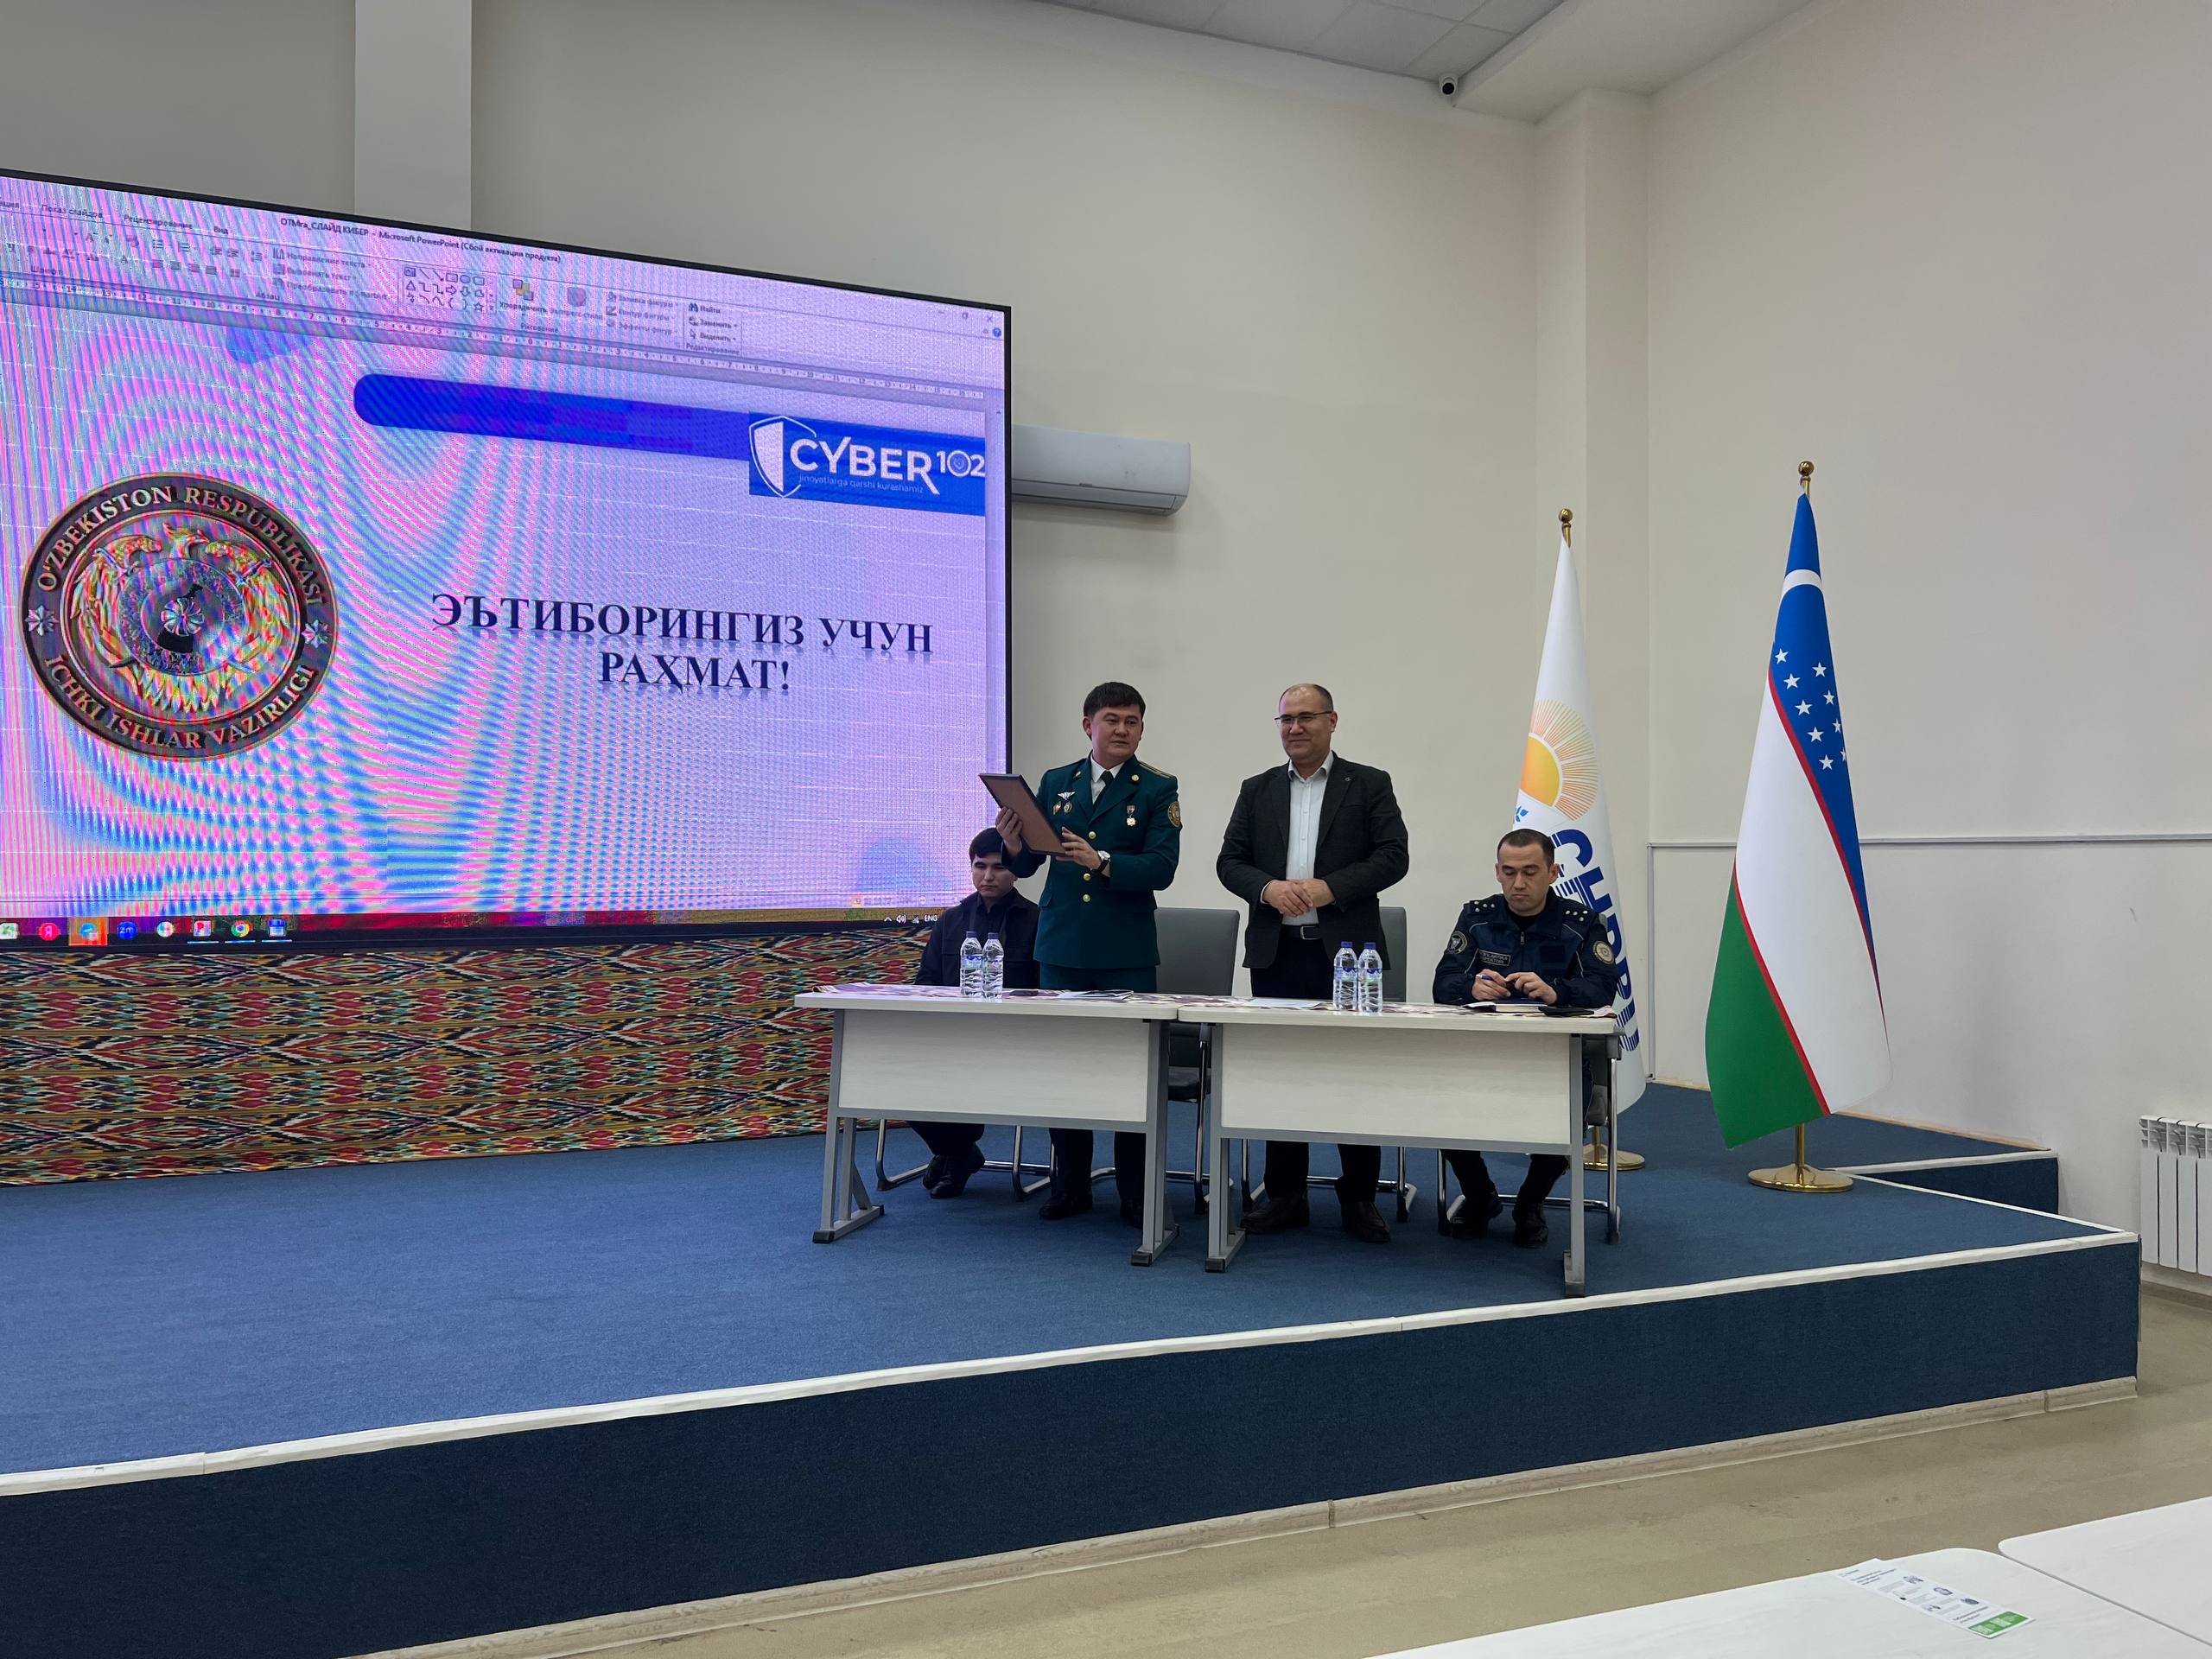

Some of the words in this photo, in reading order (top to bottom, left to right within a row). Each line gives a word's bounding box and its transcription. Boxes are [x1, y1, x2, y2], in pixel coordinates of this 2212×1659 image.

[378, 231, 416, 243] Microsoft
[416, 236, 460, 249] PowerPoint
[461, 241, 484, 252] (Сбой
[524, 252, 562, 264] продукта)
[700, 305, 721, 314] Найти
[790, 436, 940, 495] CYBER
[936, 449, 985, 477] 102
[849, 480, 875, 489] qarshi
[877, 483, 924, 493] kurashamiz
[184, 486, 324, 606] RESPUBLIKASI
[432, 593, 804, 645] ЭЪТИБОРИНГИЗ
[817, 617, 933, 652] УЧУН
[45, 654, 106, 721] ICHKI
[105, 713, 201, 749] ISHLAR
[208, 664, 315, 747] VAZIRLIGI
